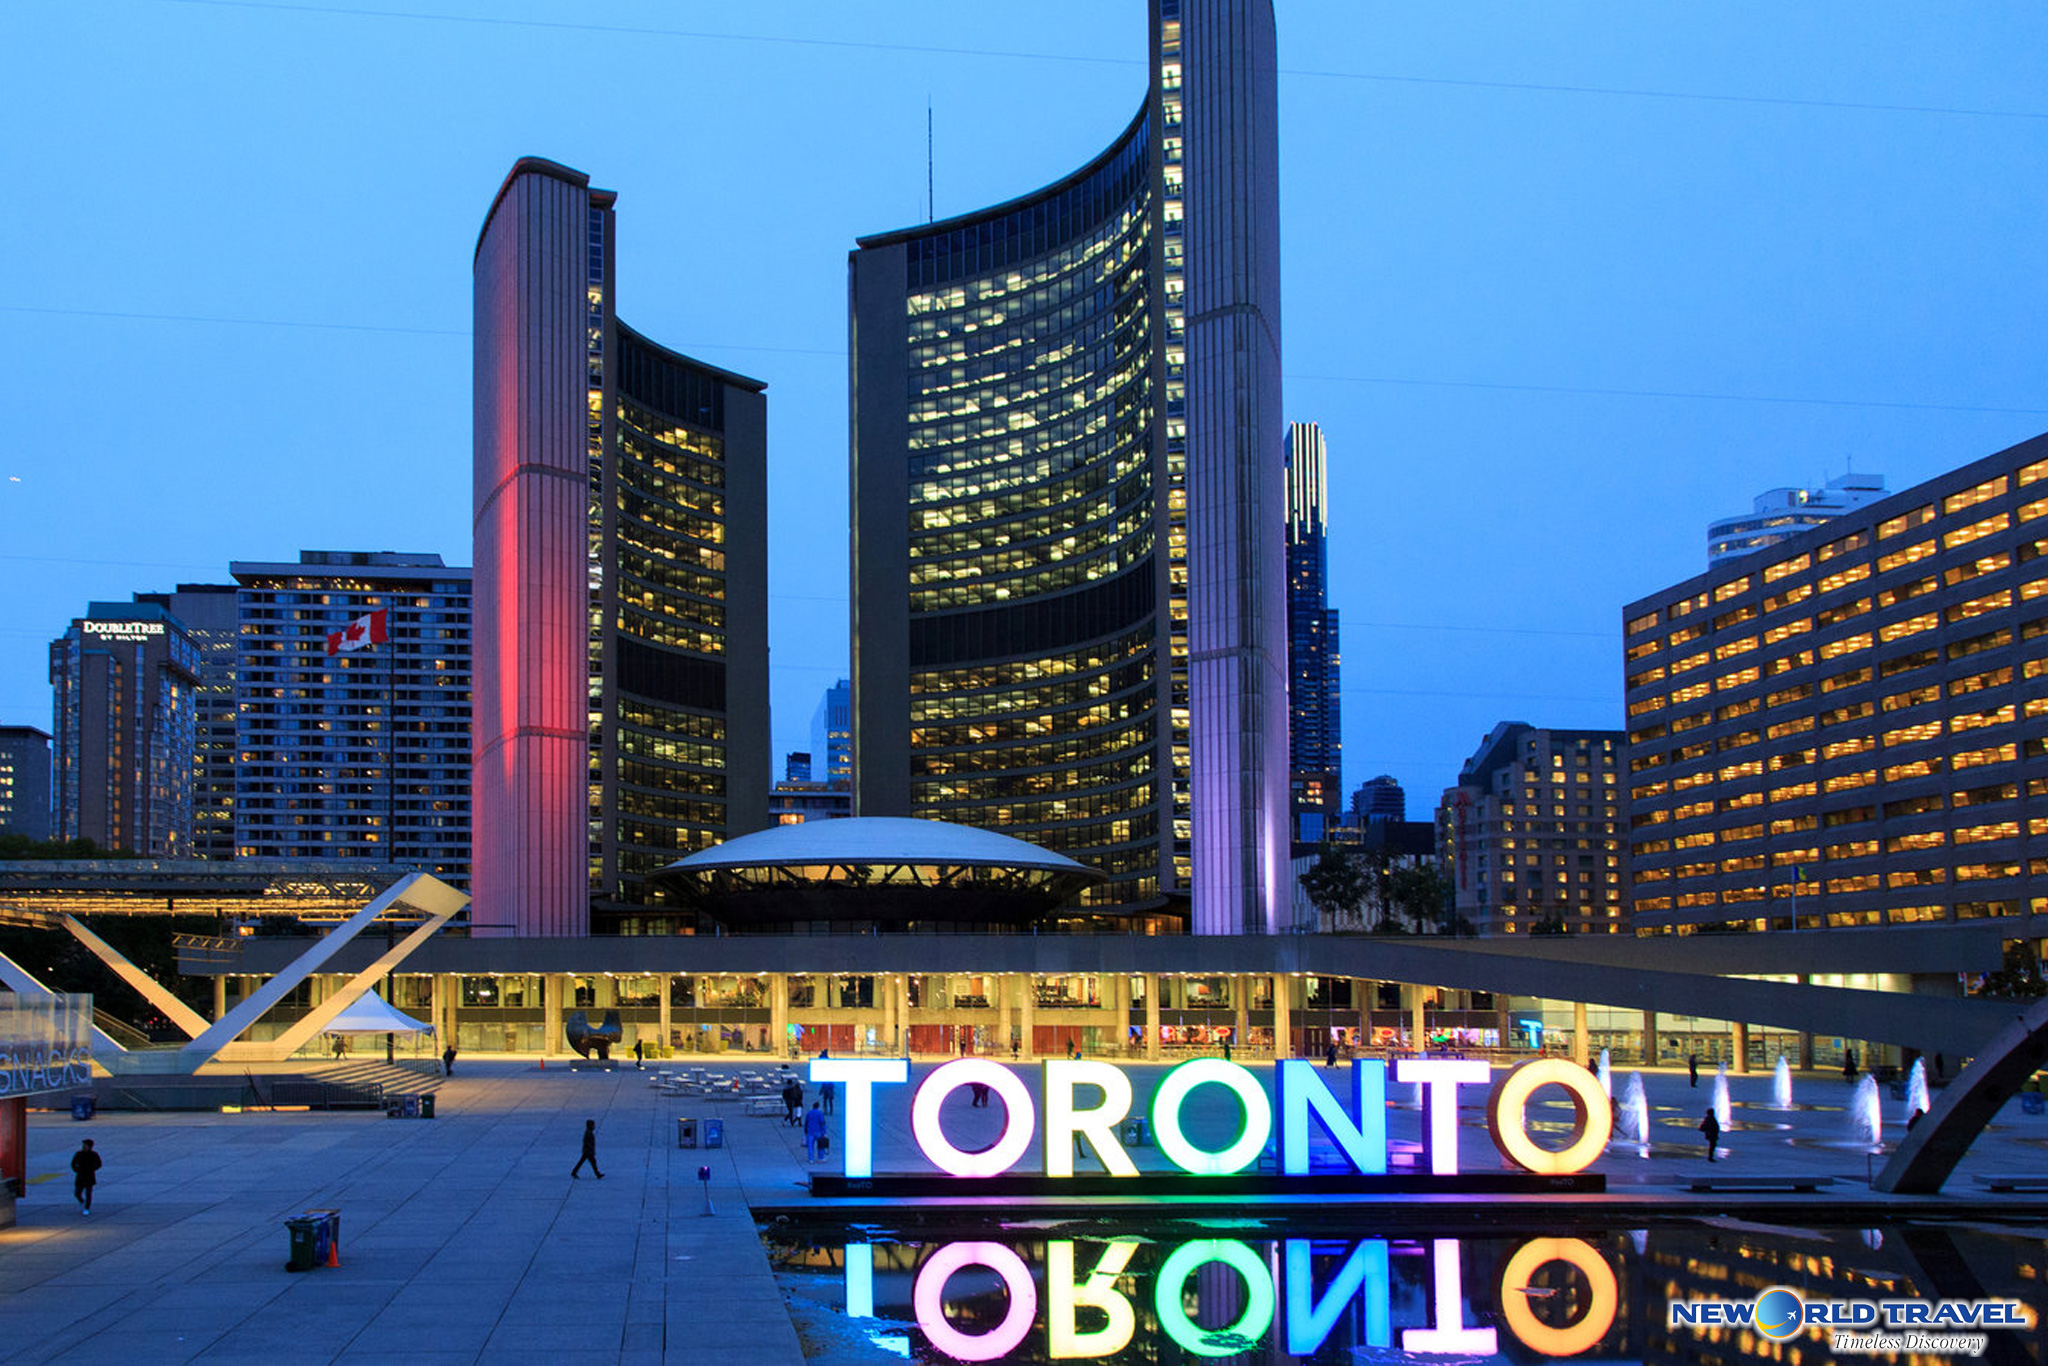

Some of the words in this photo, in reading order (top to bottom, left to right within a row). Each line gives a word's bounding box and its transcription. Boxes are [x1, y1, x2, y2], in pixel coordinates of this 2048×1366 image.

[83, 621, 165, 634] DOUBLETREE
[0, 1047, 92, 1094] SNACKS
[809, 1057, 1613, 1179] TORONTO
